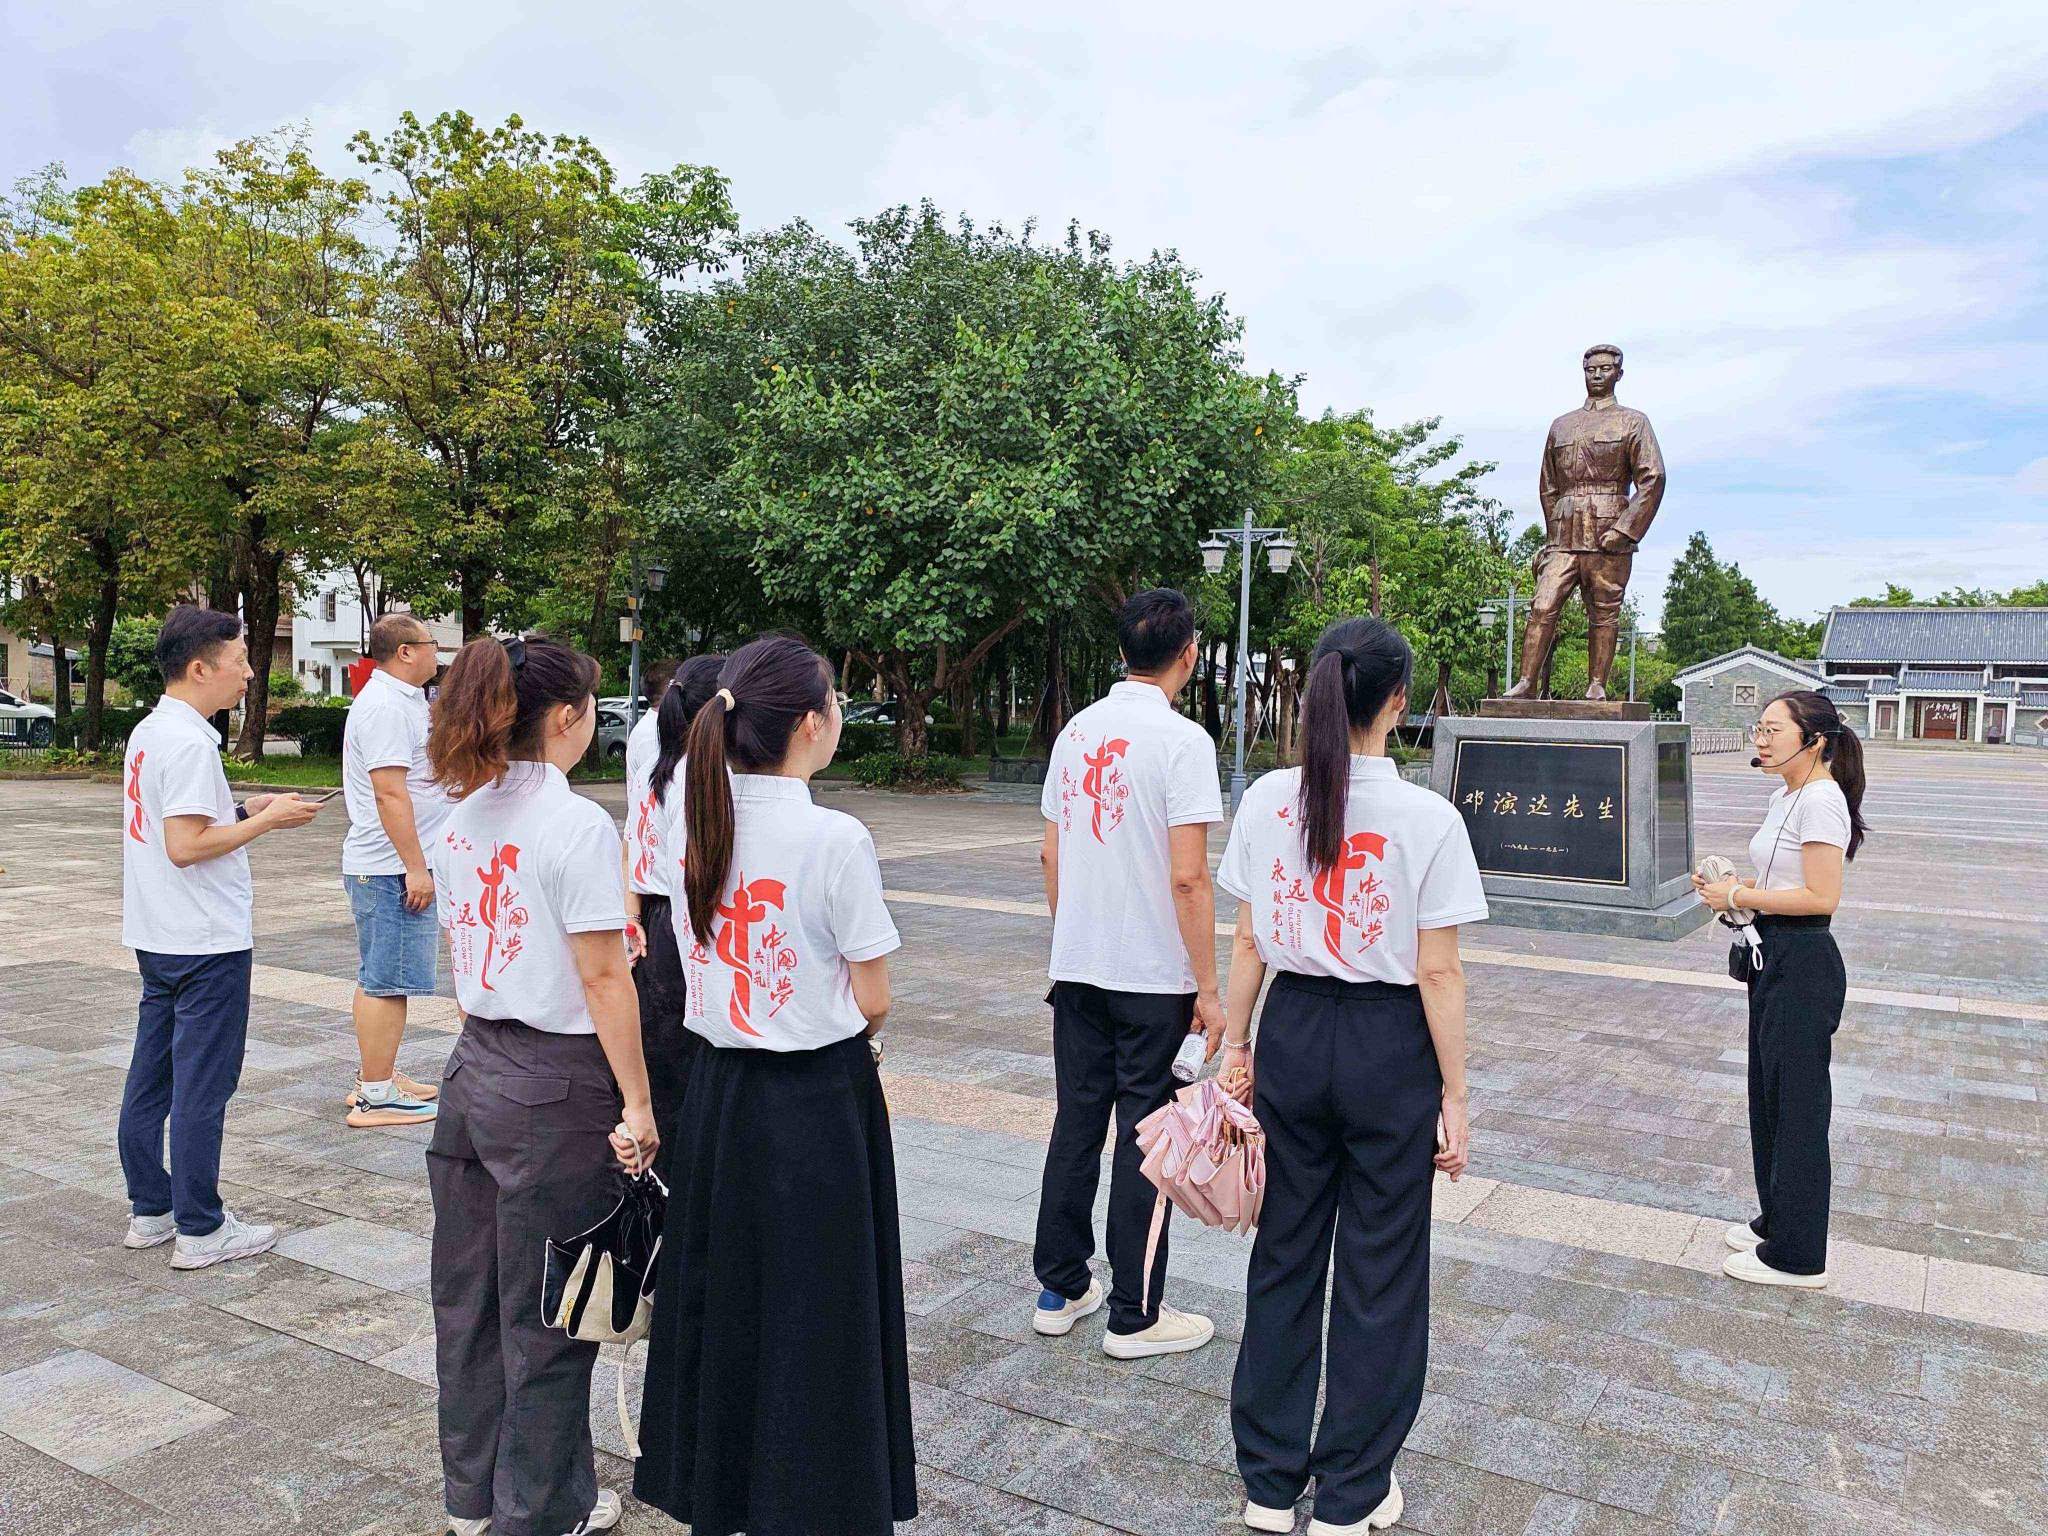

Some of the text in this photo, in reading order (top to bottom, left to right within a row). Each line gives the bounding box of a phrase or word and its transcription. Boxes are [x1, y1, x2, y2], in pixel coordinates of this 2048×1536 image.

[1462, 789, 1615, 819] 邓演达先生
[1358, 872, 1390, 954] 中国梦
[761, 923, 798, 1018] 中国梦
